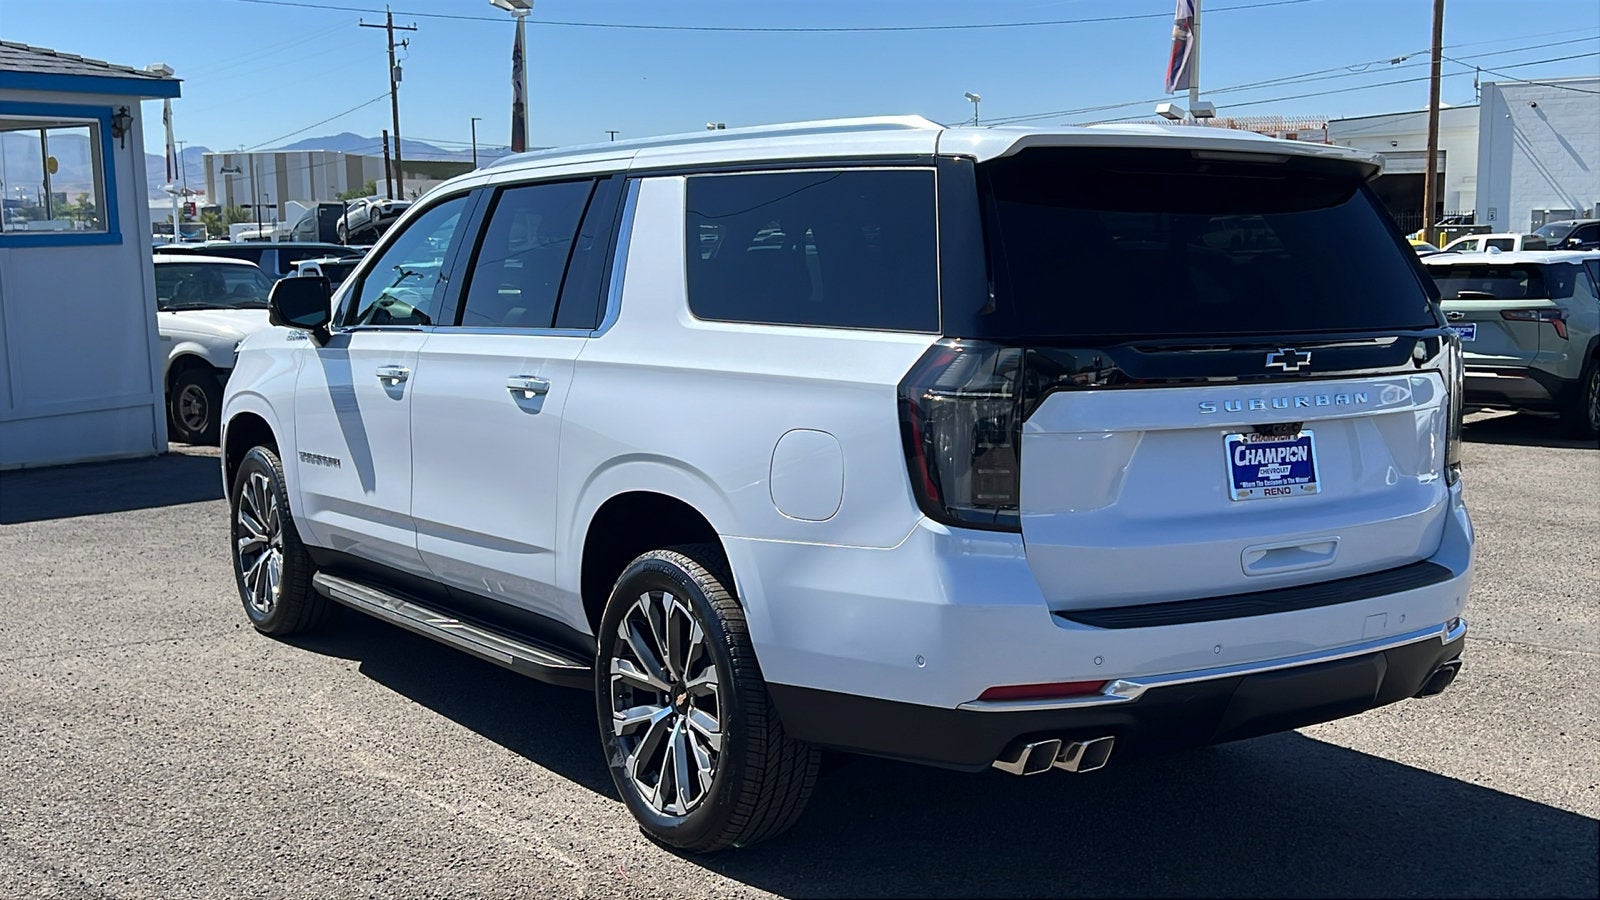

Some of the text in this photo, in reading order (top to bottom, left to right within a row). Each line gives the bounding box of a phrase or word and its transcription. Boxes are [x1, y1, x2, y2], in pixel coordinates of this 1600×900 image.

[1199, 392, 1369, 414] SUBURBAN
[1234, 445, 1308, 467] CHAMPION
[1260, 466, 1289, 475] CHEVROLET
[1264, 486, 1292, 497] RENO
